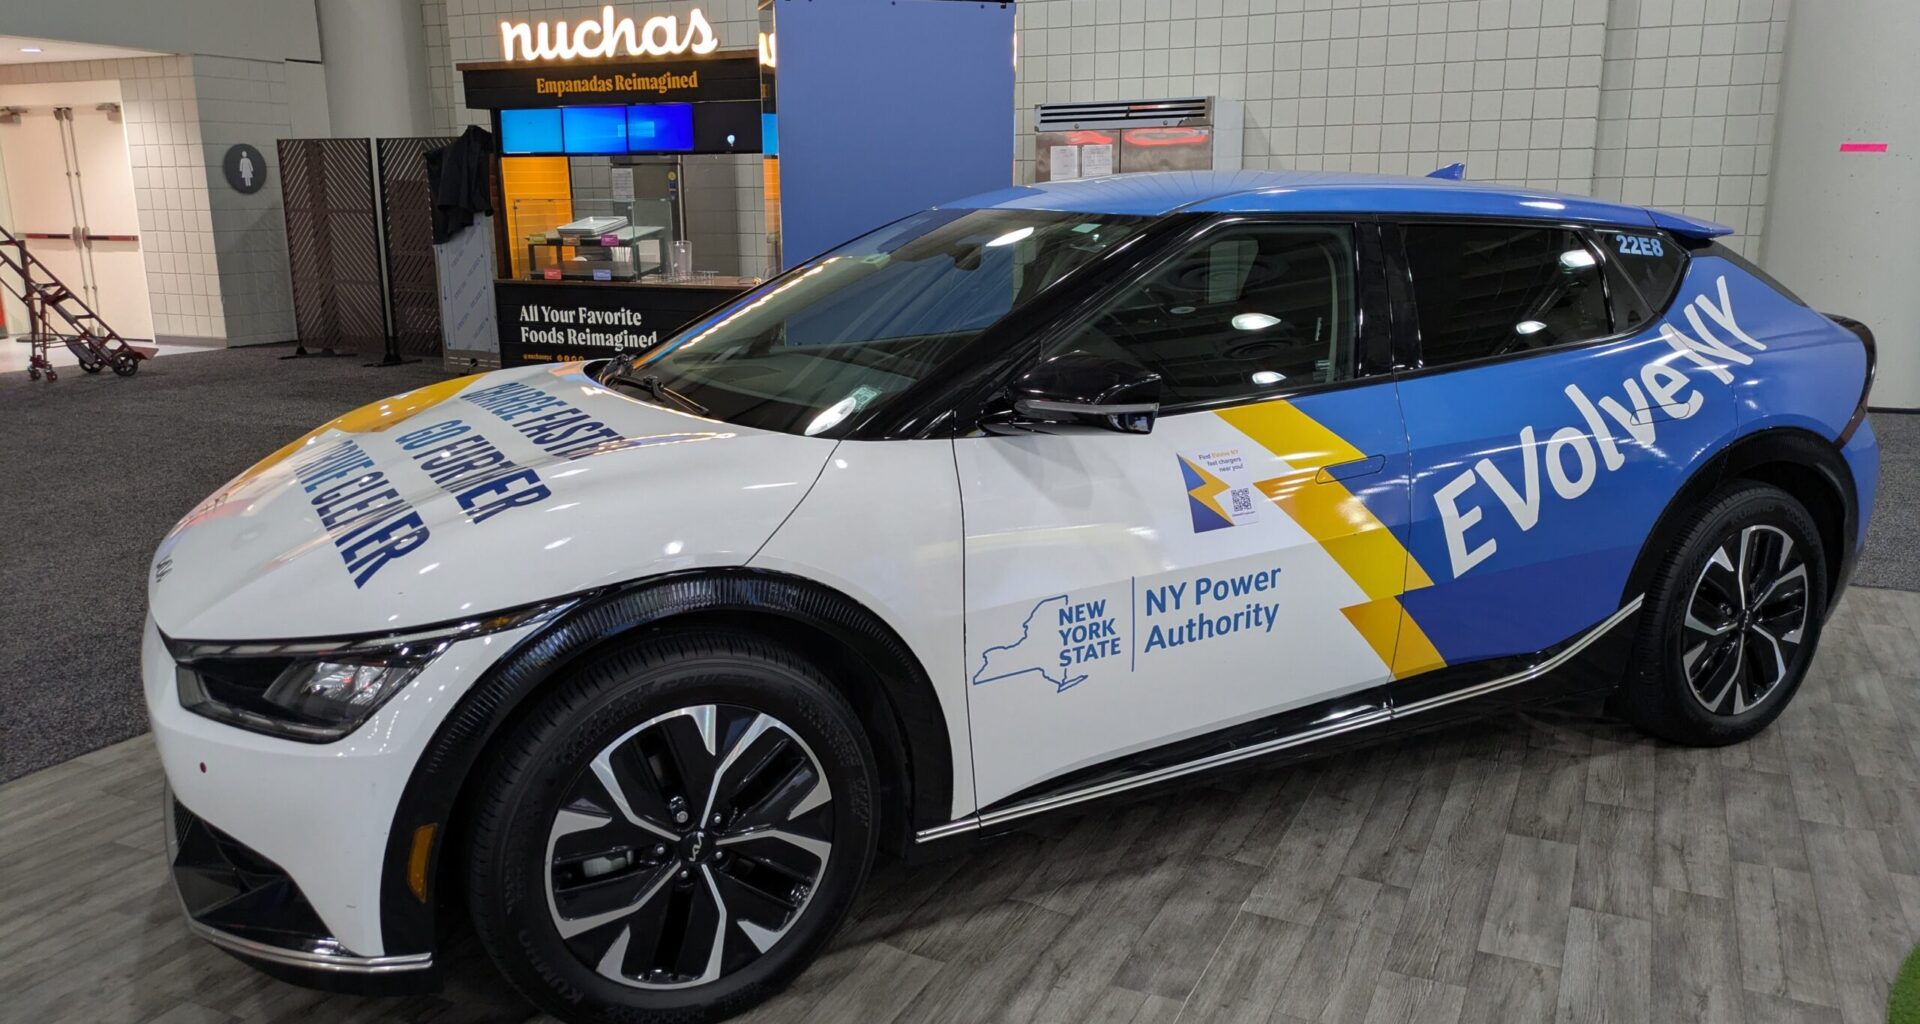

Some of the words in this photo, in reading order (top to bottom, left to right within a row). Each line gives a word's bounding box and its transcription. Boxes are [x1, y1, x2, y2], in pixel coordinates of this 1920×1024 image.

[501, 6, 718, 61] nuchas
[536, 75, 613, 96] Empanadas
[615, 71, 698, 93] Reimagined
[1615, 234, 1664, 258] 22E8
[520, 304, 539, 322] All
[541, 306, 575, 324] Your
[578, 307, 642, 326] Favorite
[520, 326, 564, 344] Foods
[567, 328, 657, 351] Reimagined
[460, 382, 568, 421] CHARGE
[395, 419, 472, 451] GO
[1145, 582, 1187, 616] NY
[1195, 567, 1281, 605] Power
[1058, 599, 1106, 626] NEW
[1058, 618, 1116, 646] YORK
[1144, 603, 1280, 653] Authority
[1059, 637, 1121, 667] STATE
